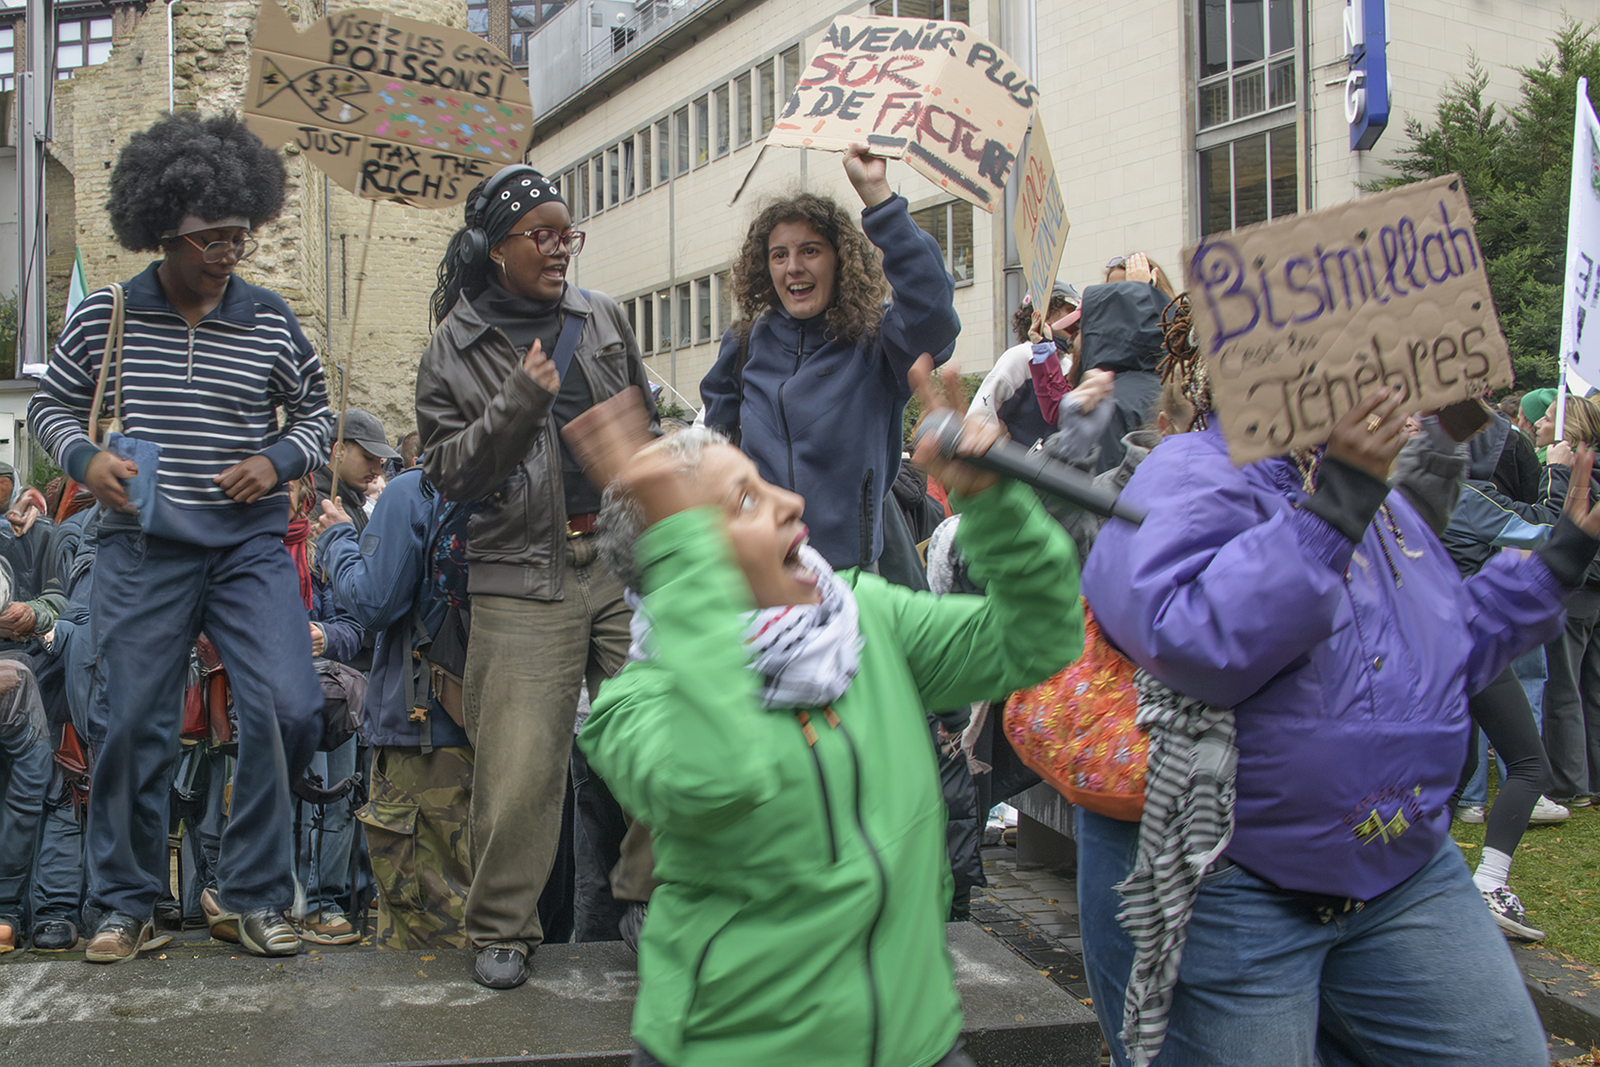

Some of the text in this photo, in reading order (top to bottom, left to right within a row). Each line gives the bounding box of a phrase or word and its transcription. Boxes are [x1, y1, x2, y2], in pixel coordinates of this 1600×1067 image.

[326, 13, 403, 46] VISEZ
[405, 32, 444, 58] LES
[822, 22, 1040, 109] AVENIR PLUS
[295, 126, 491, 177] JUST TAX THE
[804, 85, 876, 120] DE
[872, 91, 1016, 189] FACTURE
[1190, 200, 1479, 356] Bismillah
